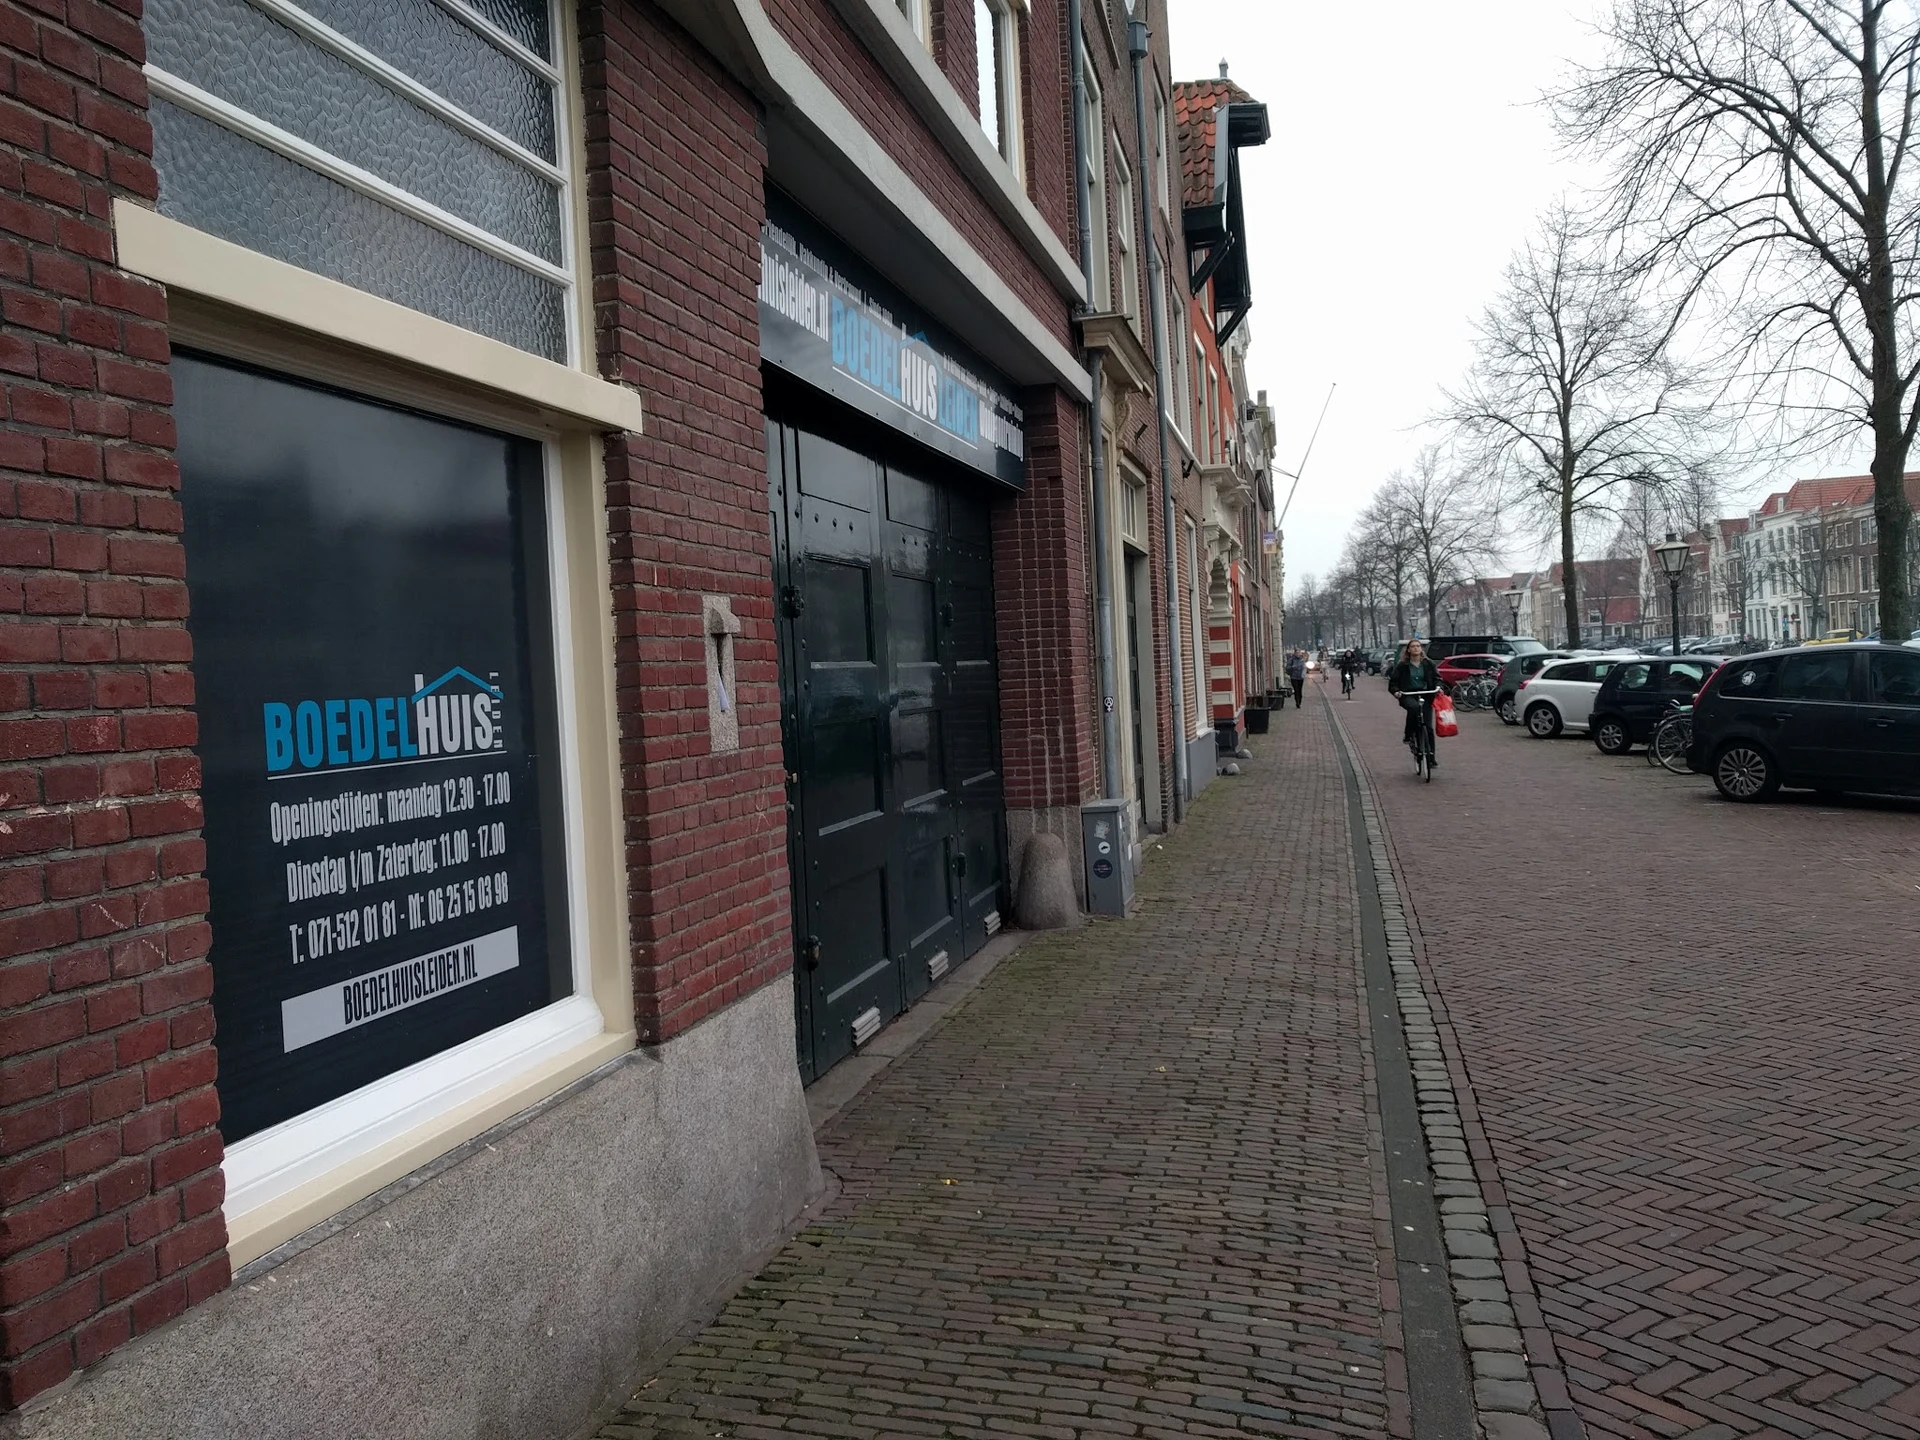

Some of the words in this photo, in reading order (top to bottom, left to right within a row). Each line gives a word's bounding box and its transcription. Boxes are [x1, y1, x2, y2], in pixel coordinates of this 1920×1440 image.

[829, 265, 834, 285] &
[489, 672, 503, 749] LEIDEN
[270, 791, 384, 847] Openingstijden:
[386, 782, 441, 818] maandag
[443, 776, 474, 813] 12.30
[482, 771, 511, 806] 17.00
[286, 856, 346, 903] Dinsdag
[349, 849, 374, 893] t/m
[376, 838, 438, 882] Zaterdag:
[440, 829, 469, 867] 11.00
[477, 822, 506, 858] 17.00
[289, 923, 305, 965] T:
[307, 909, 361, 960] 071-512
[363, 904, 379, 943] 01
[381, 899, 397, 938] 81
[407, 892, 426, 931] M:
[428, 887, 444, 924] 06
[446, 883, 461, 919] 25
[462, 879, 476, 914] 15
[478, 875, 493, 910] 03
[494, 871, 509, 905] 98
[343, 943, 478, 1025] BOEDELHUISLEIDEN.NL
